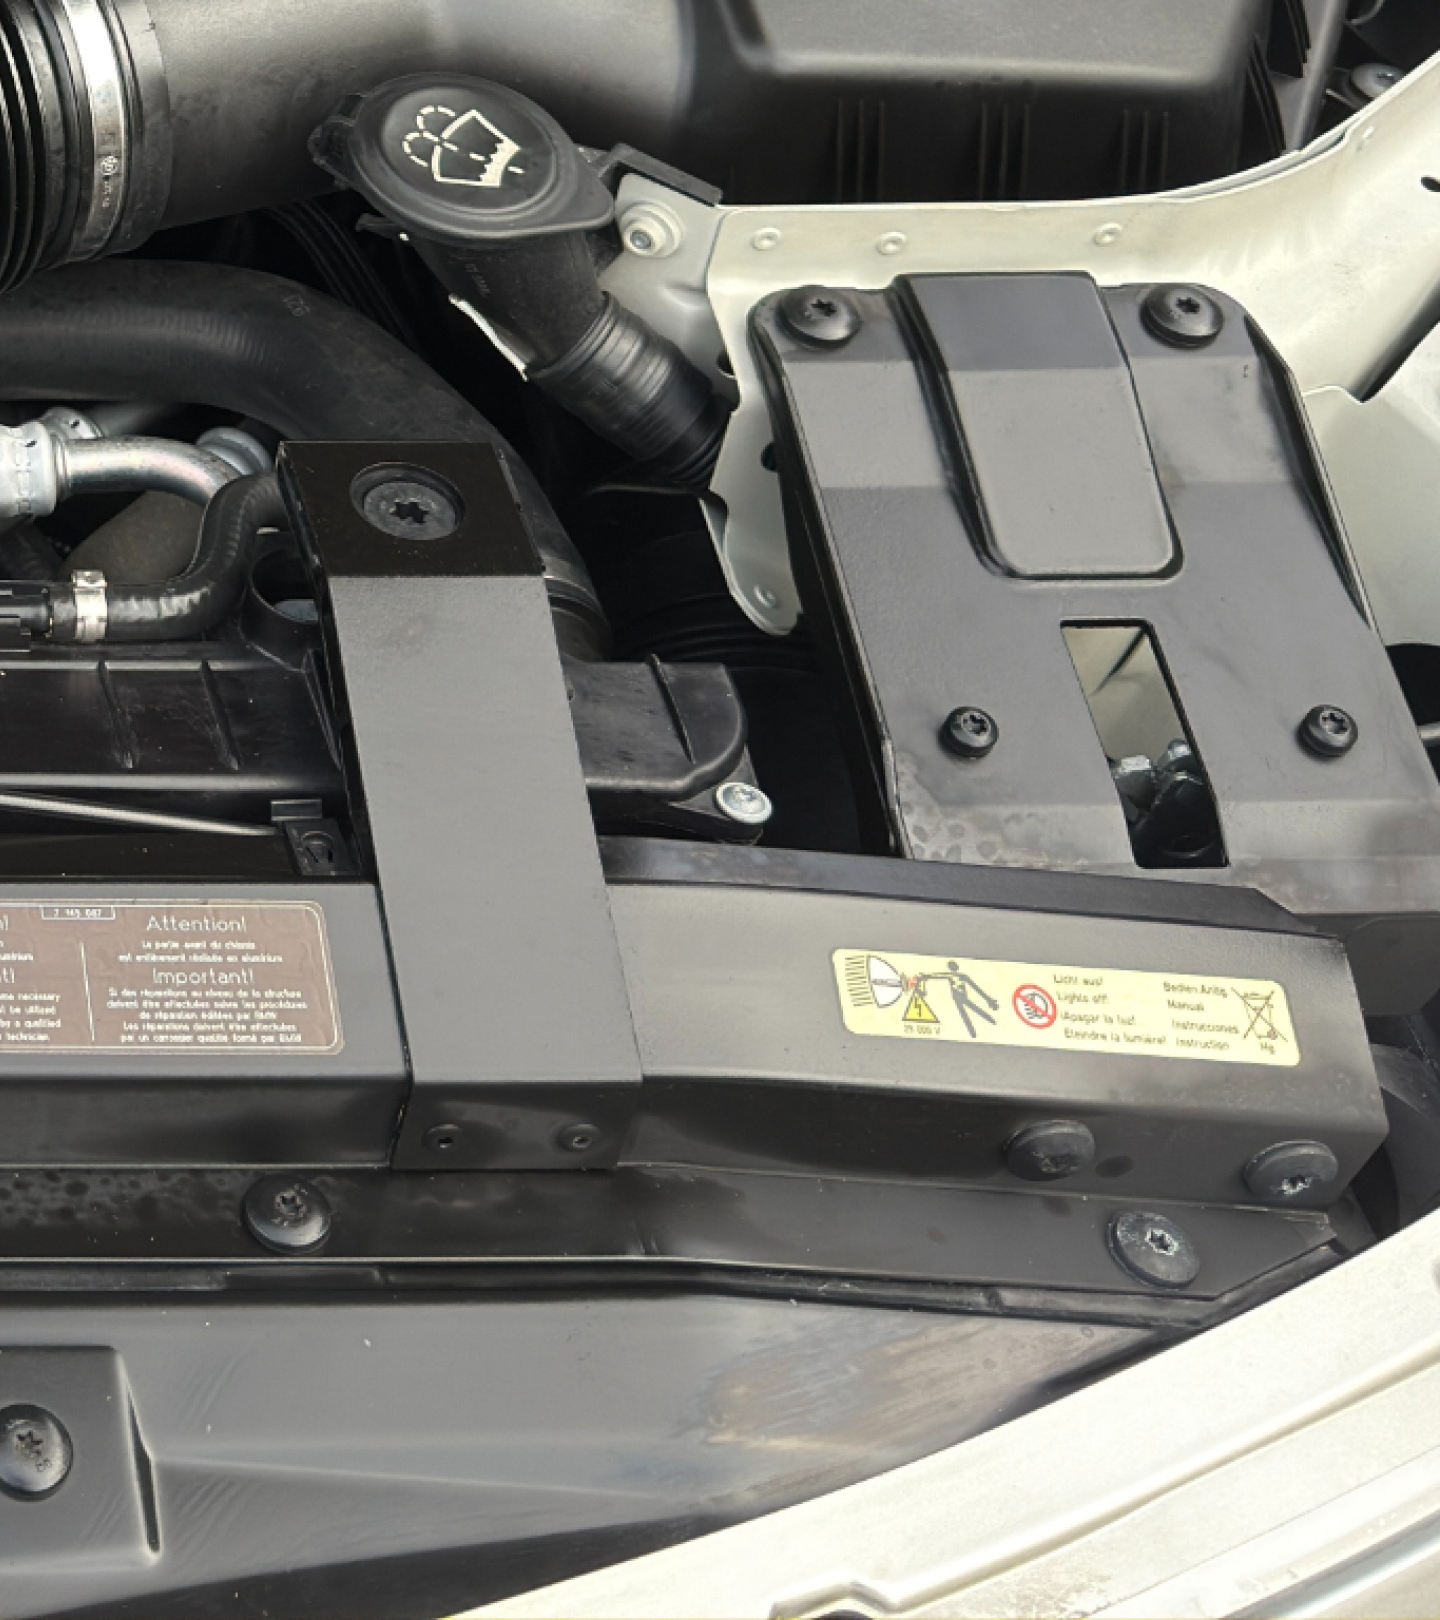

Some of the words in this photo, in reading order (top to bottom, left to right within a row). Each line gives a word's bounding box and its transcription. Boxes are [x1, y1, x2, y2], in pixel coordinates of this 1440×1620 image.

[146, 915, 247, 933] Attention!
[152, 968, 255, 985] Important!
[1167, 999, 1204, 1012] Manual
[1176, 1037, 1229, 1050] Instruction
[1260, 1042, 1275, 1055] Hg
